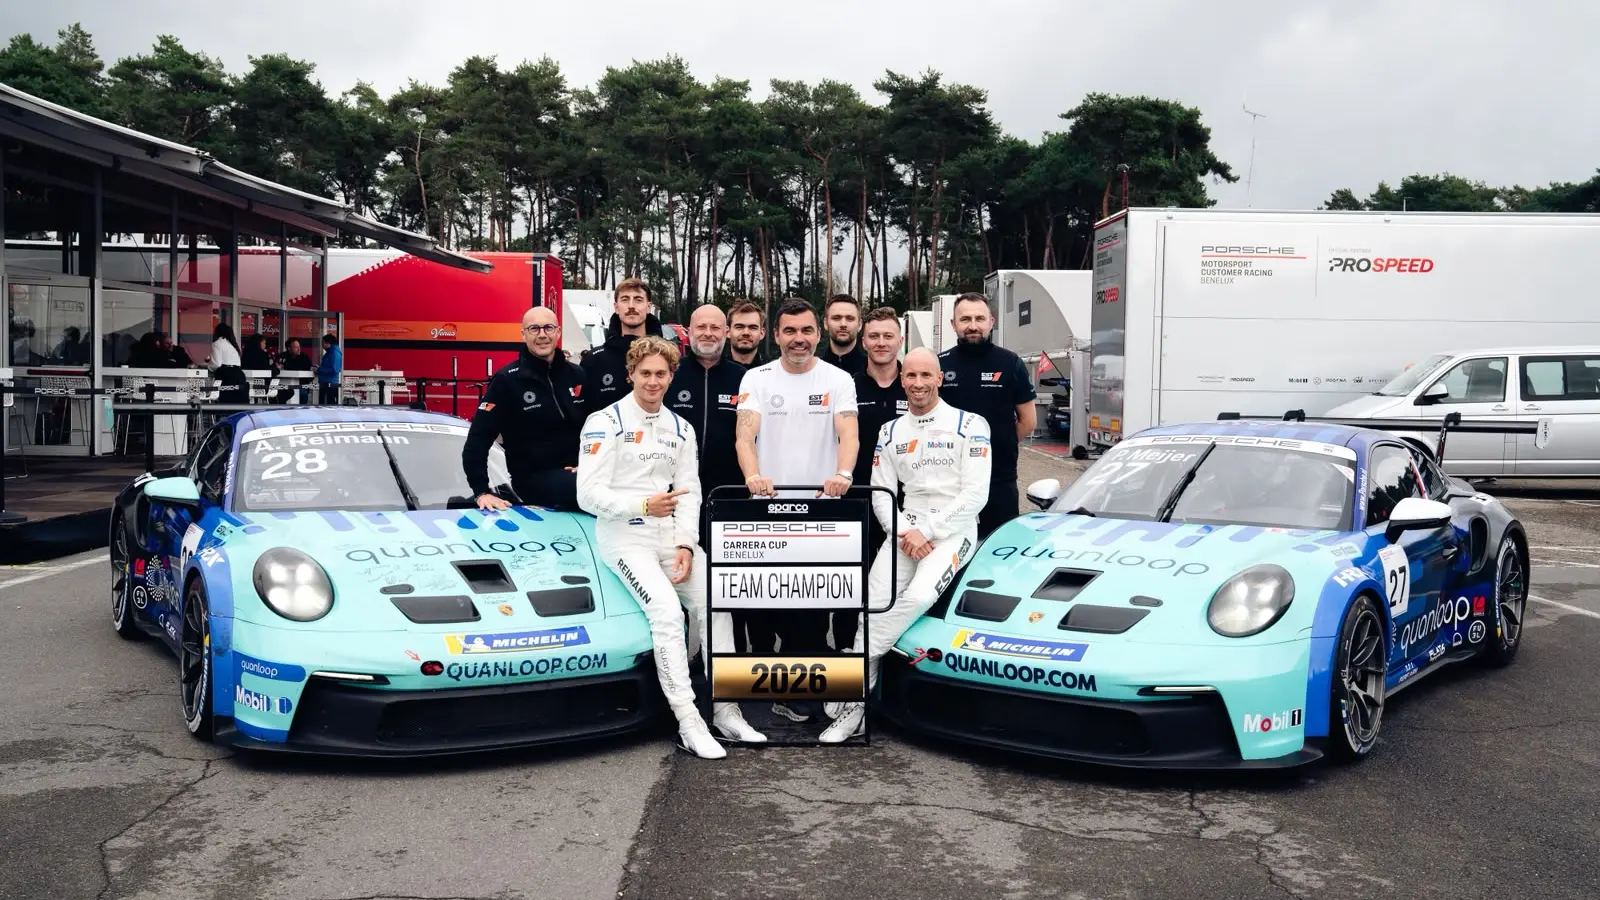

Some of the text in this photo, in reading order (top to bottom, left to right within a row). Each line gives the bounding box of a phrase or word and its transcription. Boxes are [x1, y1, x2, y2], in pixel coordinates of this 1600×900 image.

[1201, 245, 1295, 254] PORSCHE
[1201, 260, 1252, 268] MOTORSPORT
[1328, 257, 1434, 273] PROSPEED
[430, 328, 456, 339] Venus
[293, 423, 452, 434] PORSCHE
[254, 440, 281, 454] A.
[288, 433, 410, 448] Reimann
[927, 441, 946, 449] Mobil
[1152, 436, 1302, 449] PORSCHE
[261, 448, 328, 481] 28
[1130, 449, 1196, 464] Meijer
[1087, 462, 1150, 487] 27
[768, 503, 809, 514] sparco
[722, 523, 836, 532] PORSCHE
[345, 539, 576, 565] quanloop
[723, 541, 788, 549] CARRERA CUP
[723, 551, 765, 559] BENELUX
[991, 543, 1210, 577] quanloop
[617, 558, 652, 604] REIMANN
[719, 573, 853, 599] TEAM CHAMPION
[1389, 565, 1407, 607] 27
[1400, 596, 1470, 658] quanloop
[492, 631, 579, 648] MICHELIN
[988, 640, 1076, 657] MICHELIN
[241, 660, 278, 678] quanloop
[446, 653, 608, 681] QUANLOOP.COM
[946, 652, 1098, 692] QUANLOOP.COM
[751, 663, 827, 694] 2026
[236, 685, 267, 712] Mobil
[1243, 710, 1301, 732] Mobil 1
